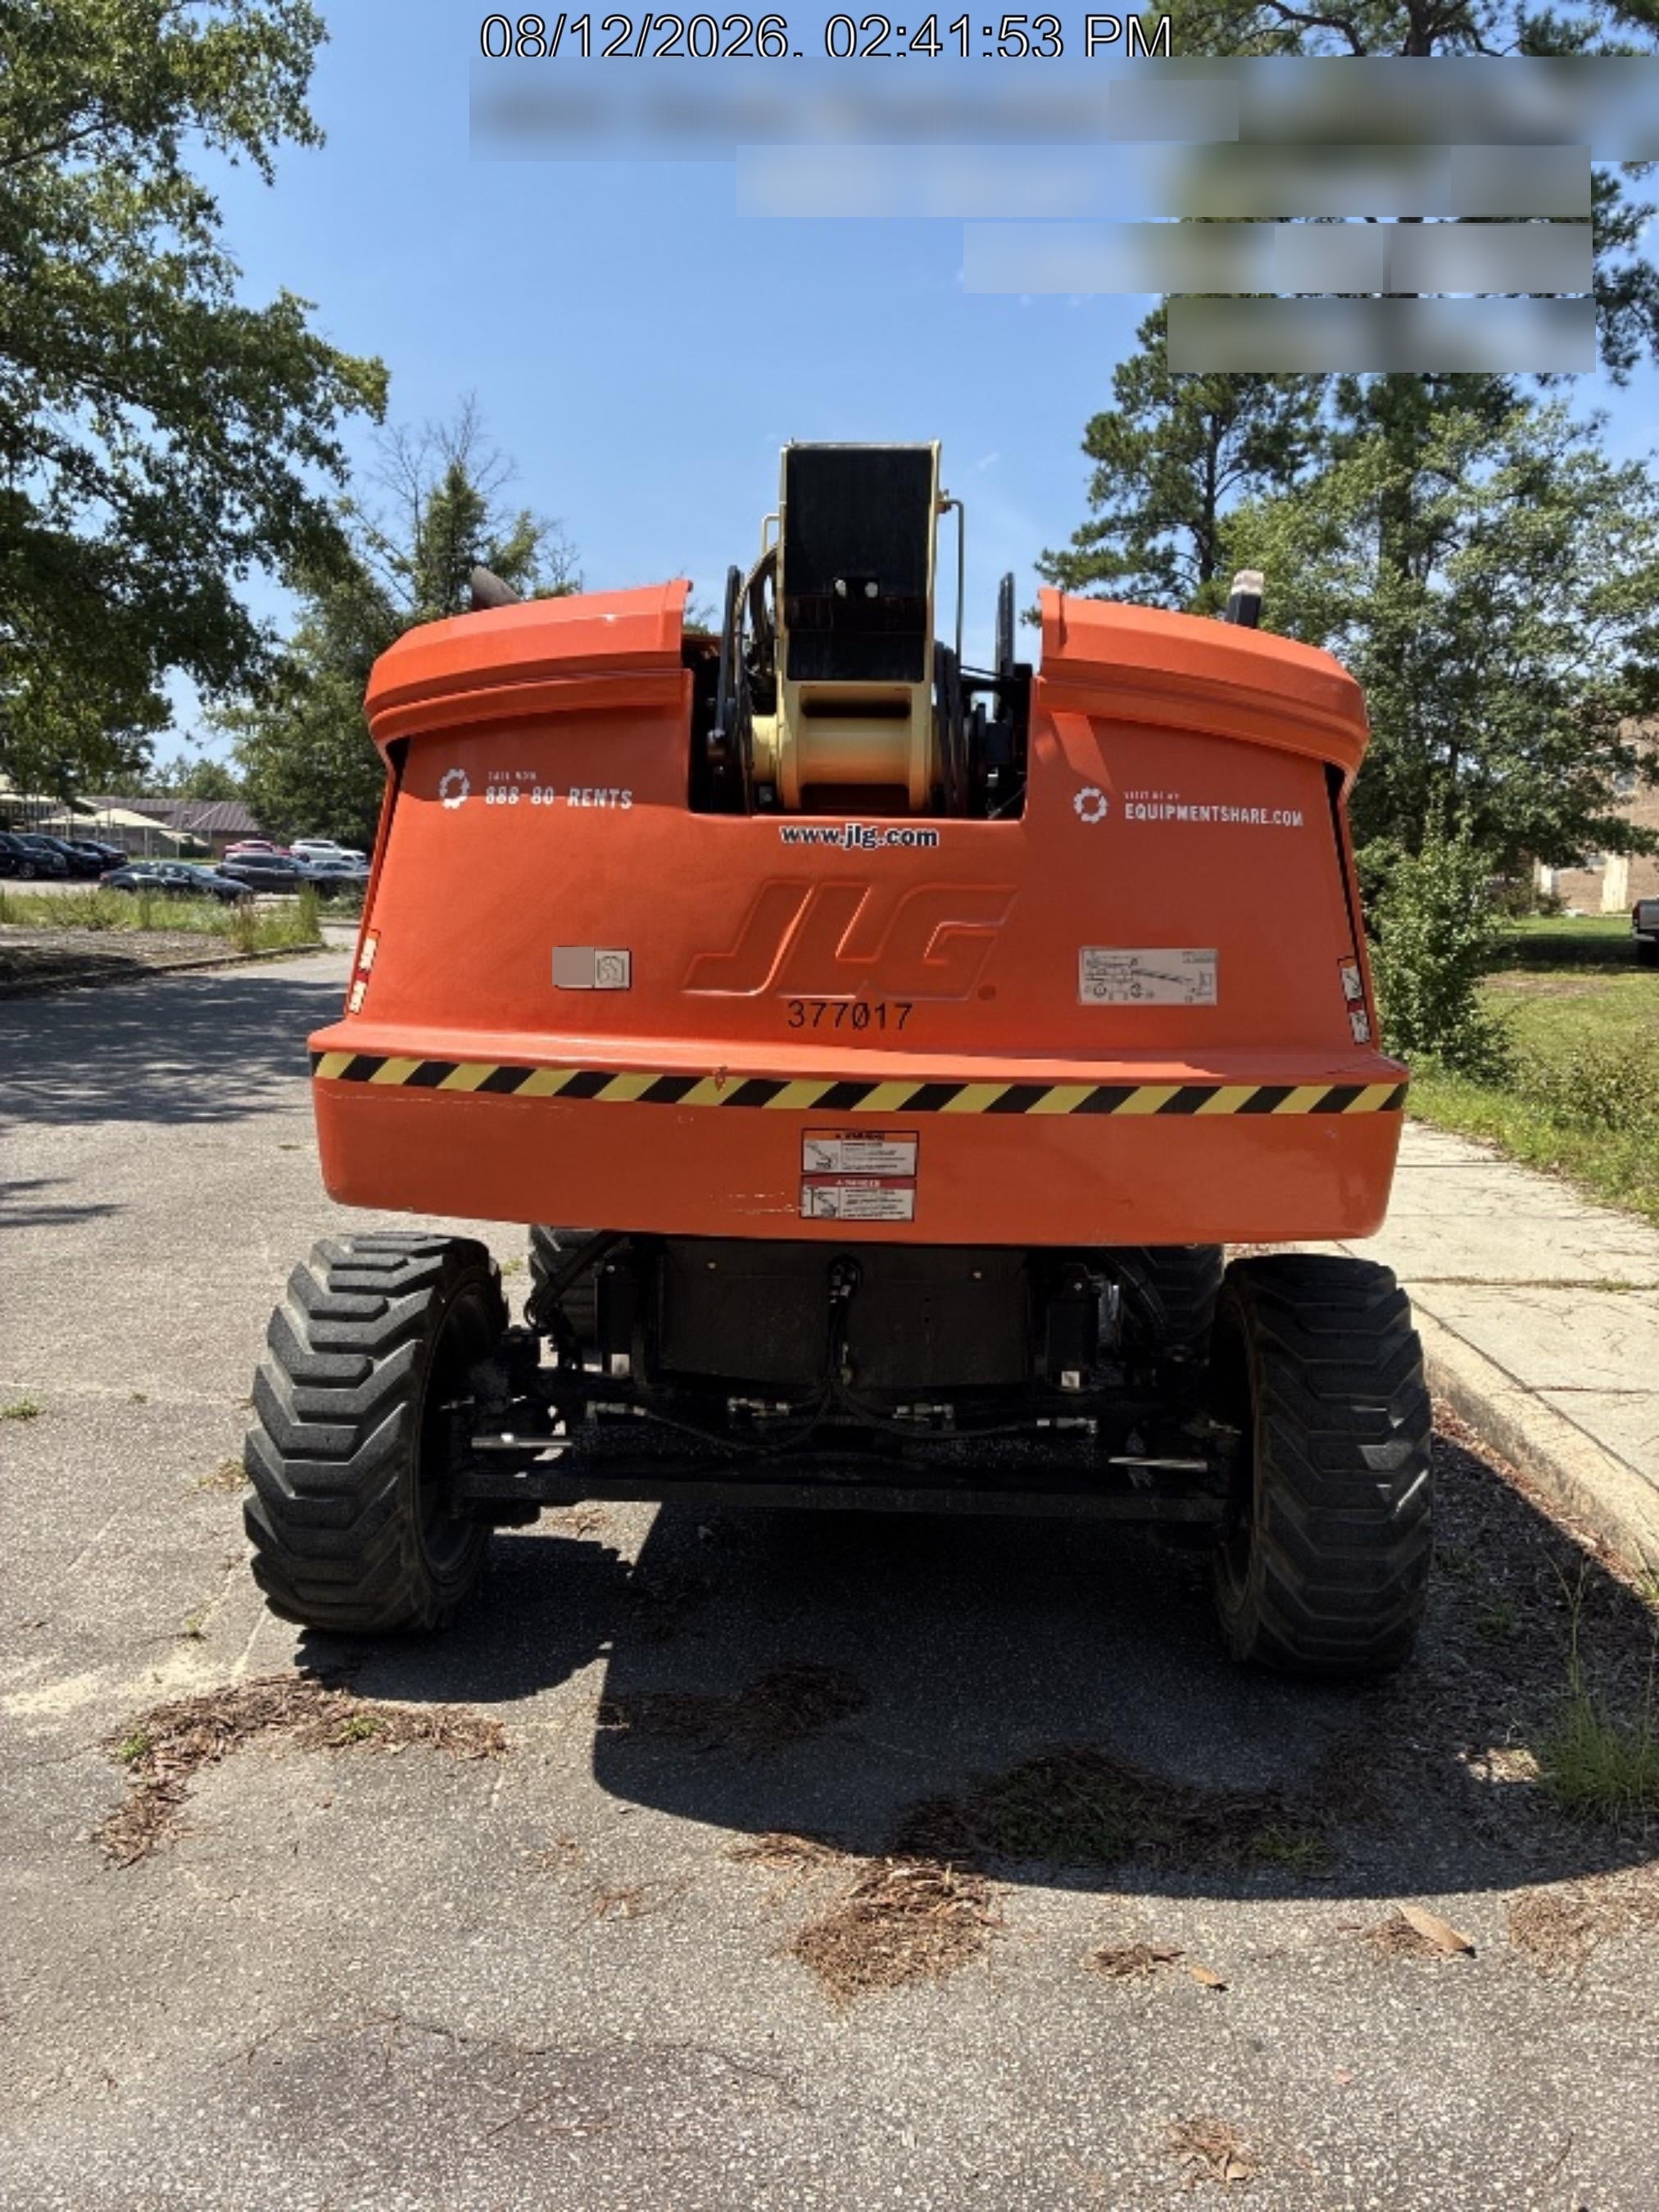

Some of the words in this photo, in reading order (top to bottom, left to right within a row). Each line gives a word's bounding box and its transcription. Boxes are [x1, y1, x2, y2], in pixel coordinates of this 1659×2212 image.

[567, 787, 632, 809] RENTS
[1125, 803, 1303, 827] EQUIPMENTSHARE.COM
[779, 823, 939, 850] www.jlg.com
[681, 877, 1020, 1001] JLG
[787, 999, 913, 1030] 377017
